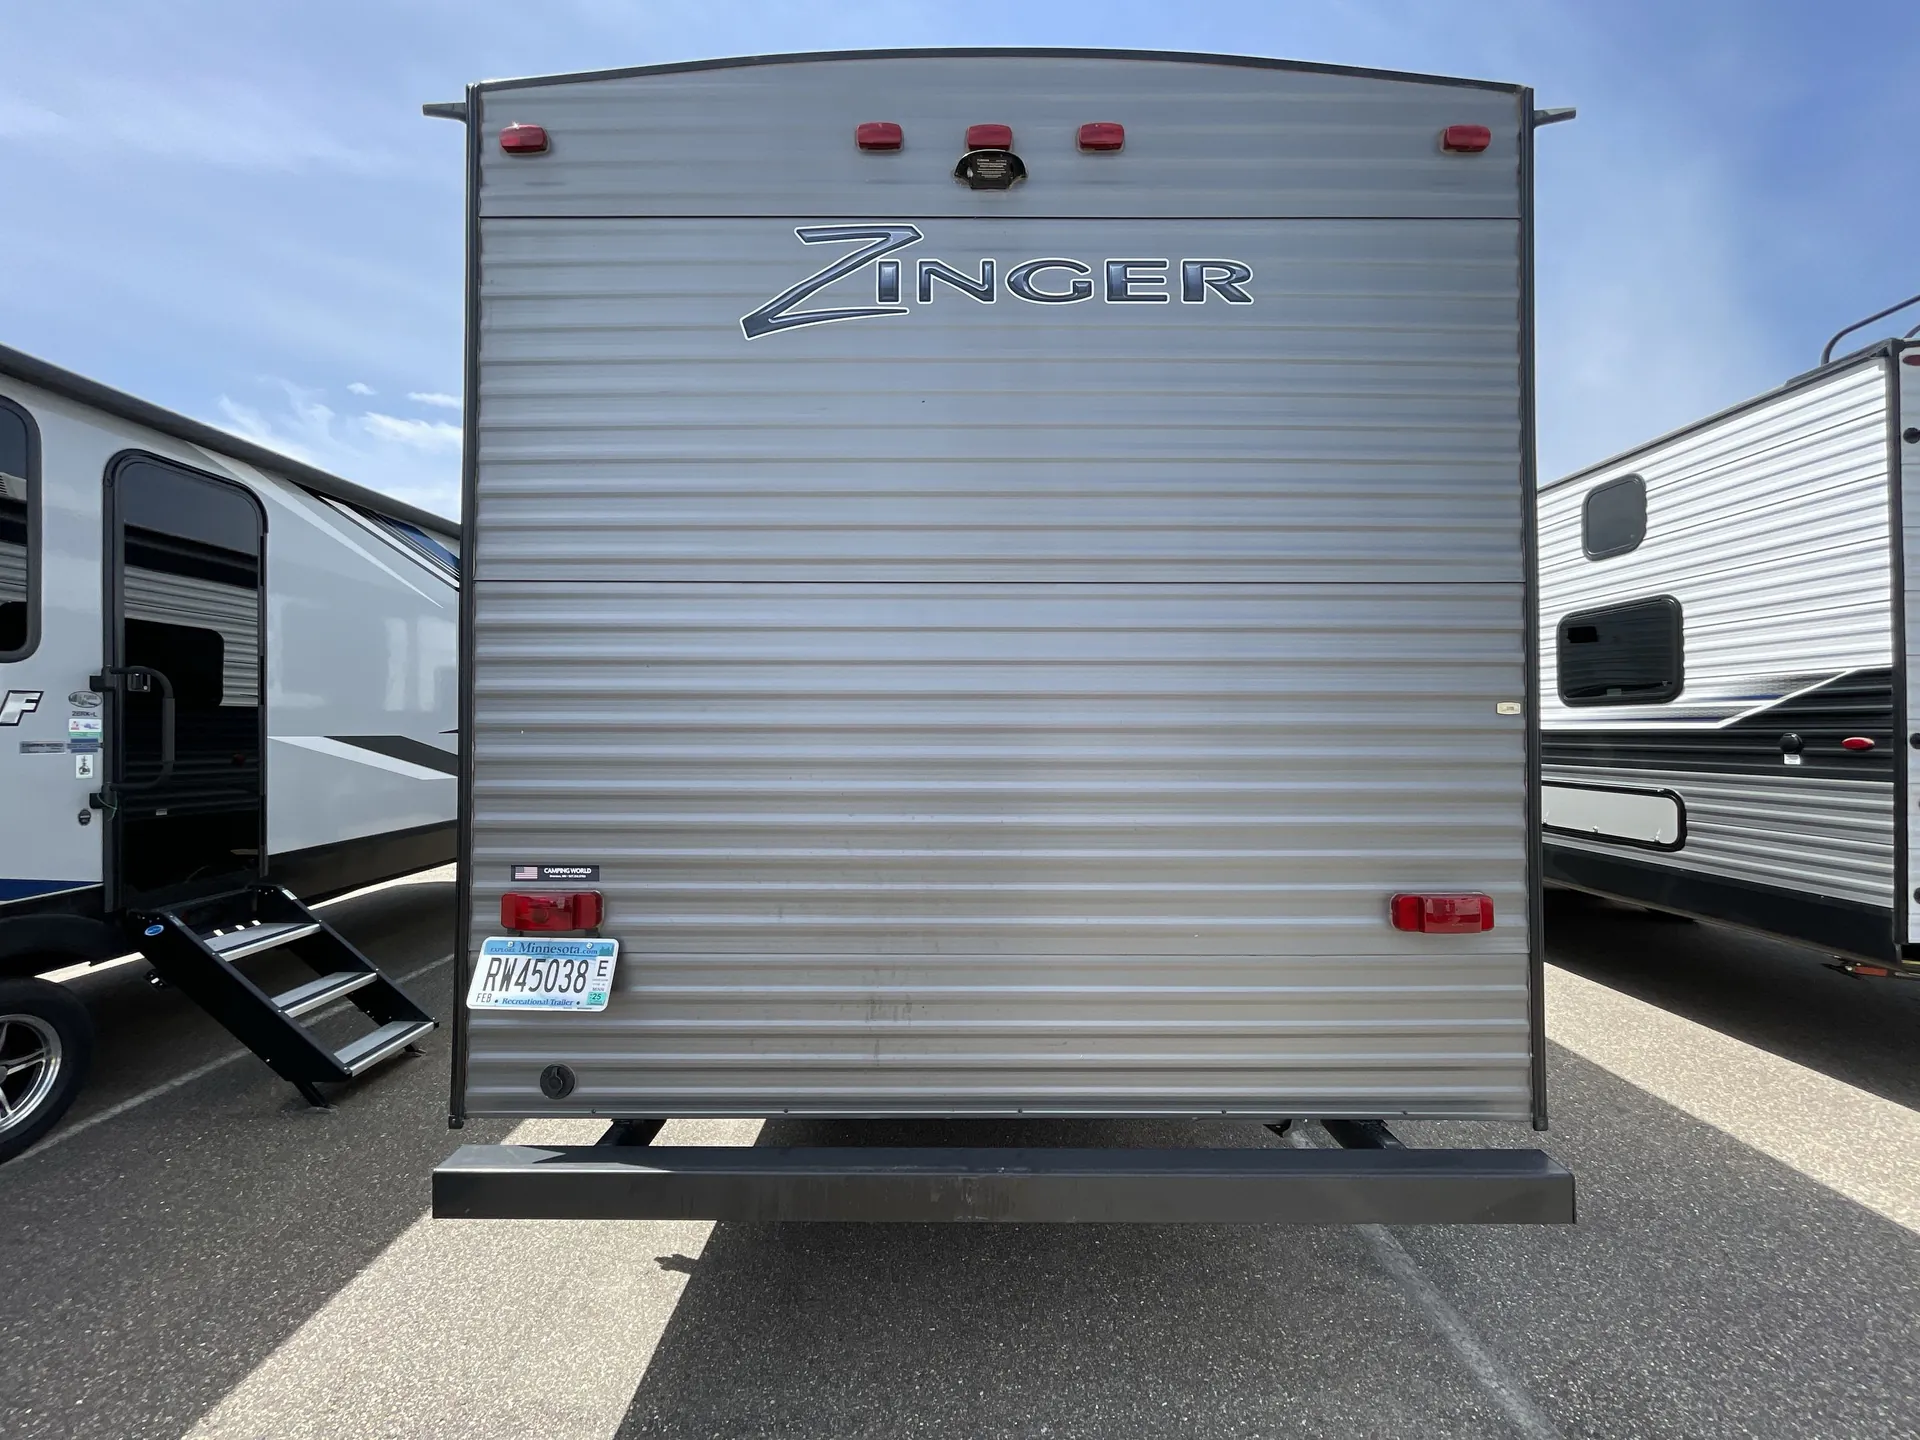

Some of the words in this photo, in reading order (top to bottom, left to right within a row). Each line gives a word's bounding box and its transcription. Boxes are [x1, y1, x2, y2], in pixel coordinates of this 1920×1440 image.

[739, 223, 1254, 341] ZINGER
[0, 690, 44, 726] F
[482, 957, 589, 994] RW45038
[596, 960, 609, 977] E
[475, 993, 492, 1003] FEB
[501, 997, 549, 1006] Recreational
[550, 998, 574, 1007] Trailer
